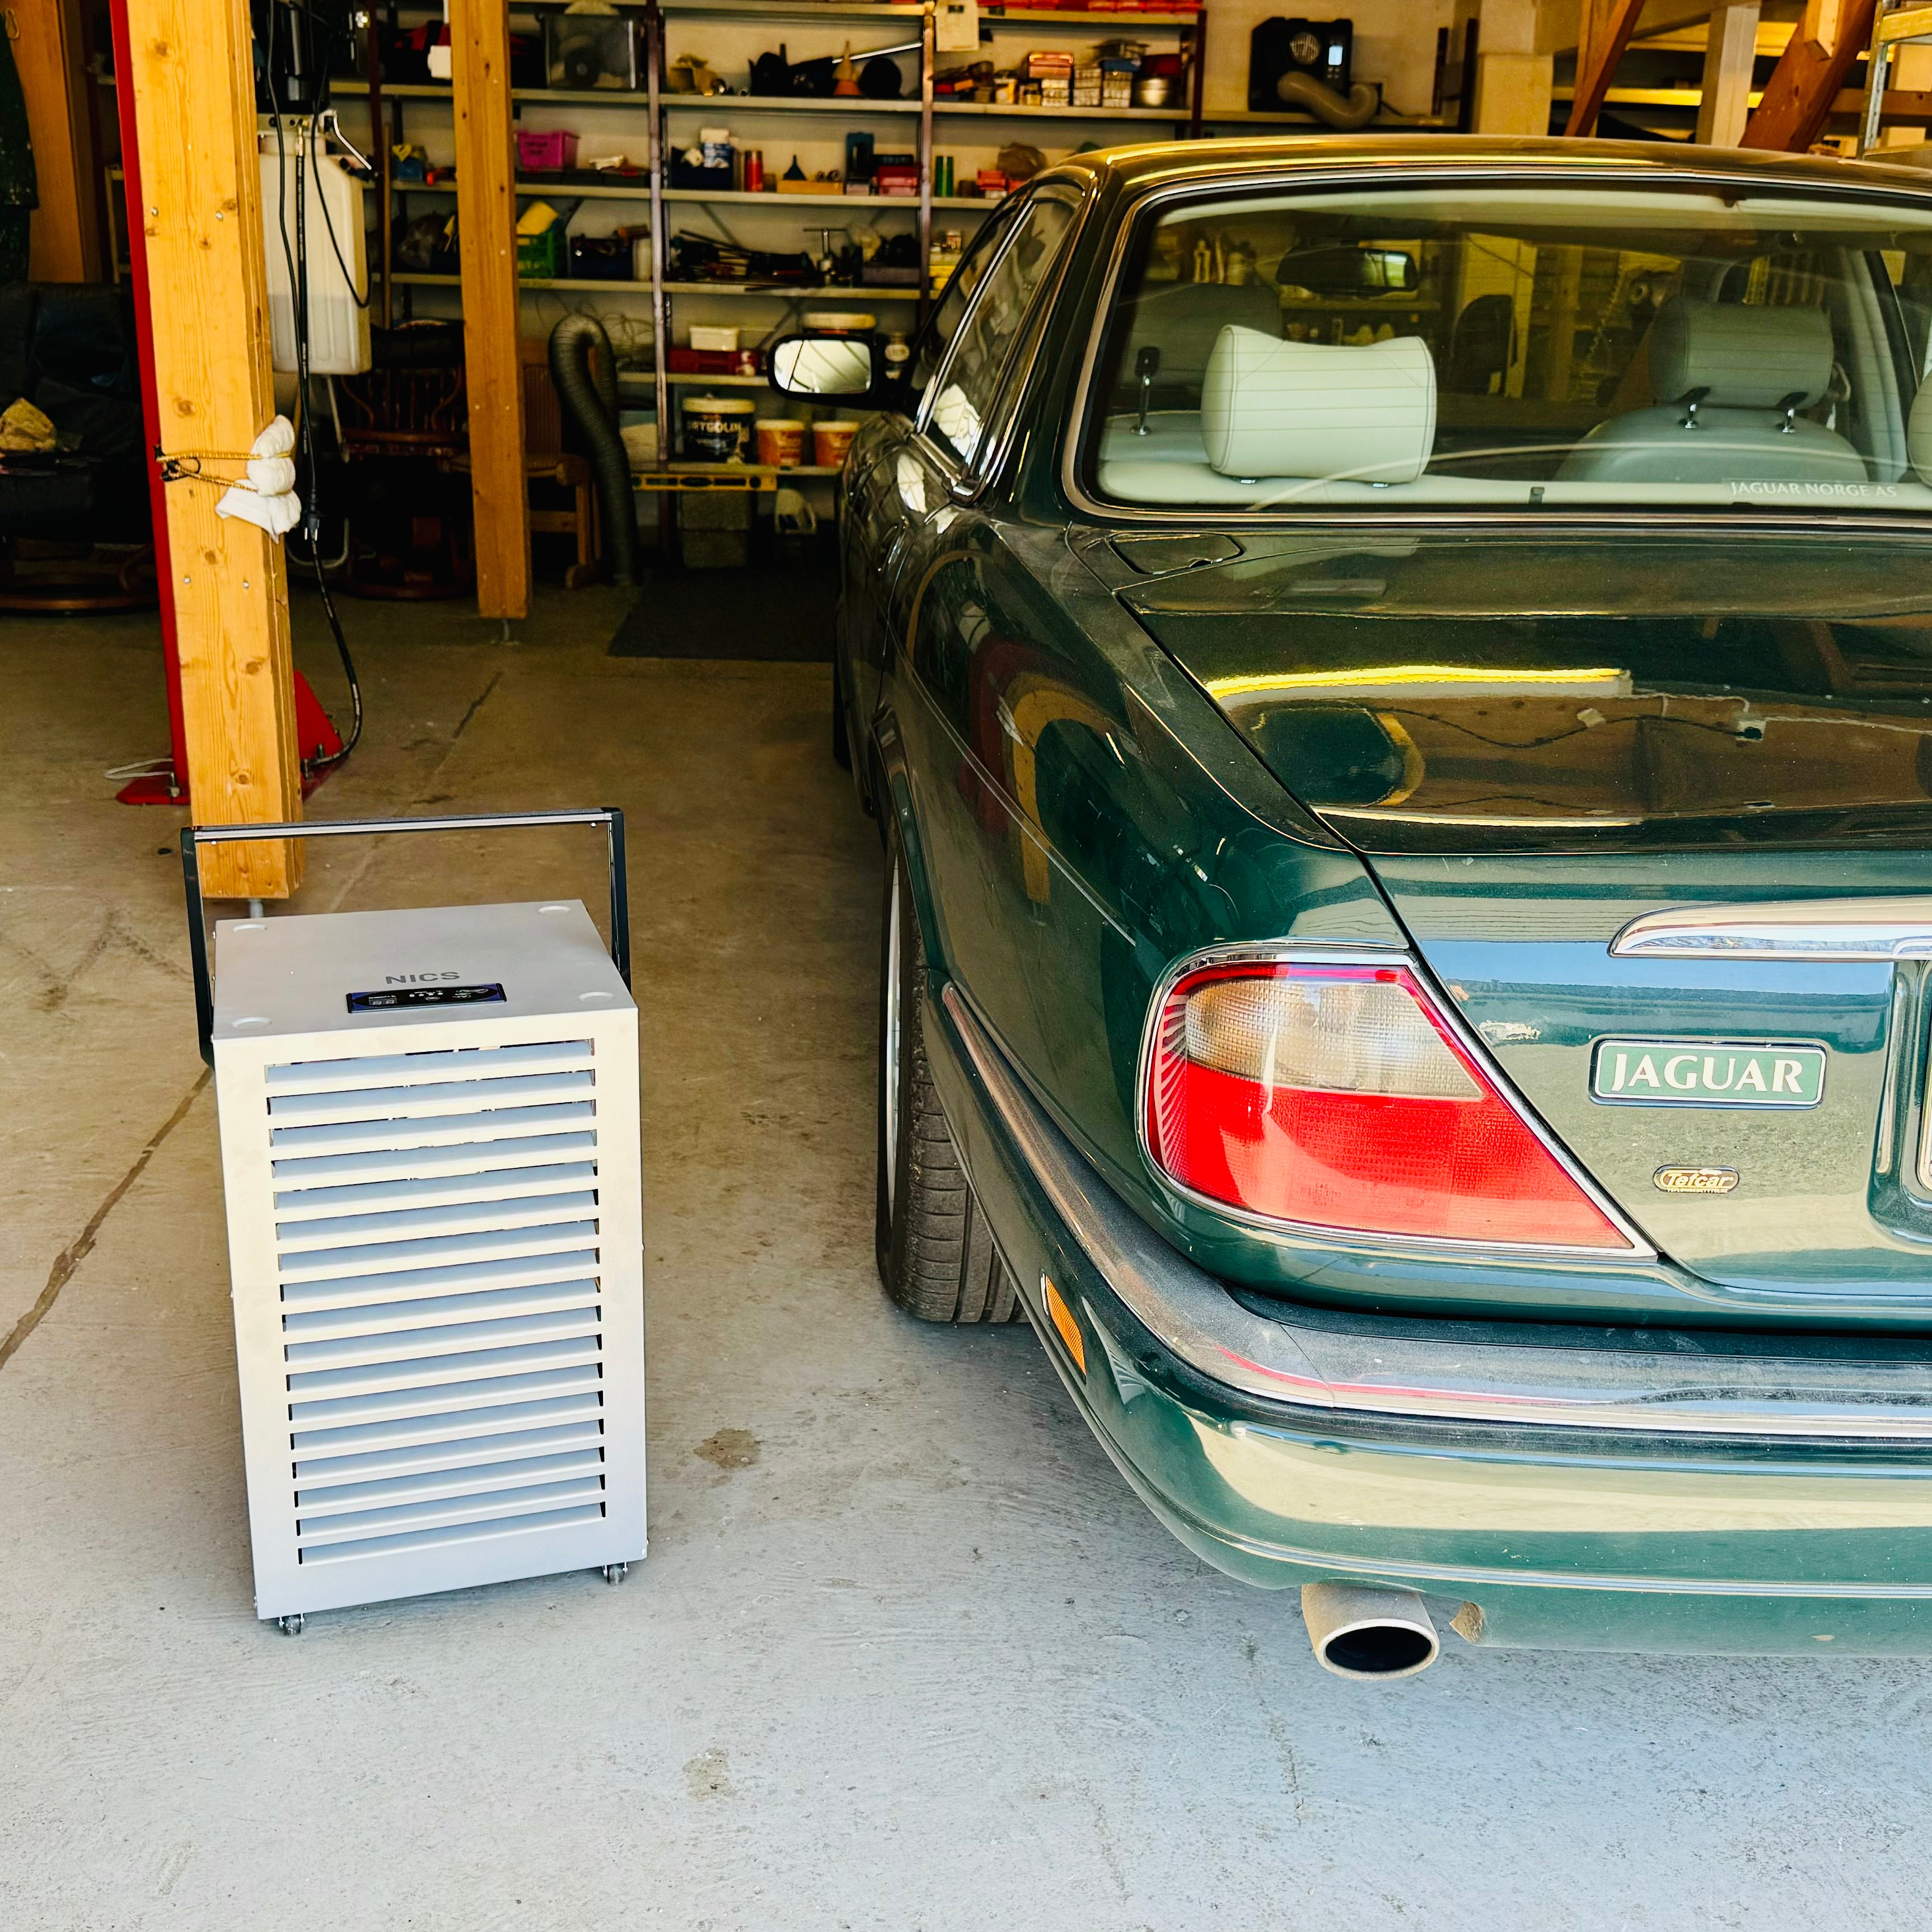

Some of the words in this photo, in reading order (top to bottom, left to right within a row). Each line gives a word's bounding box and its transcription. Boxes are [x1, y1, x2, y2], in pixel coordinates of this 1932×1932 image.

[1730, 482, 1801, 495] JAGUAR
[1805, 483, 1870, 497] NORGE
[1876, 485, 1897, 497] AS
[386, 972, 460, 984] NICS
[1611, 1053, 1803, 1093] JAGUAR
[1668, 1173, 1730, 1187] Tefcar
